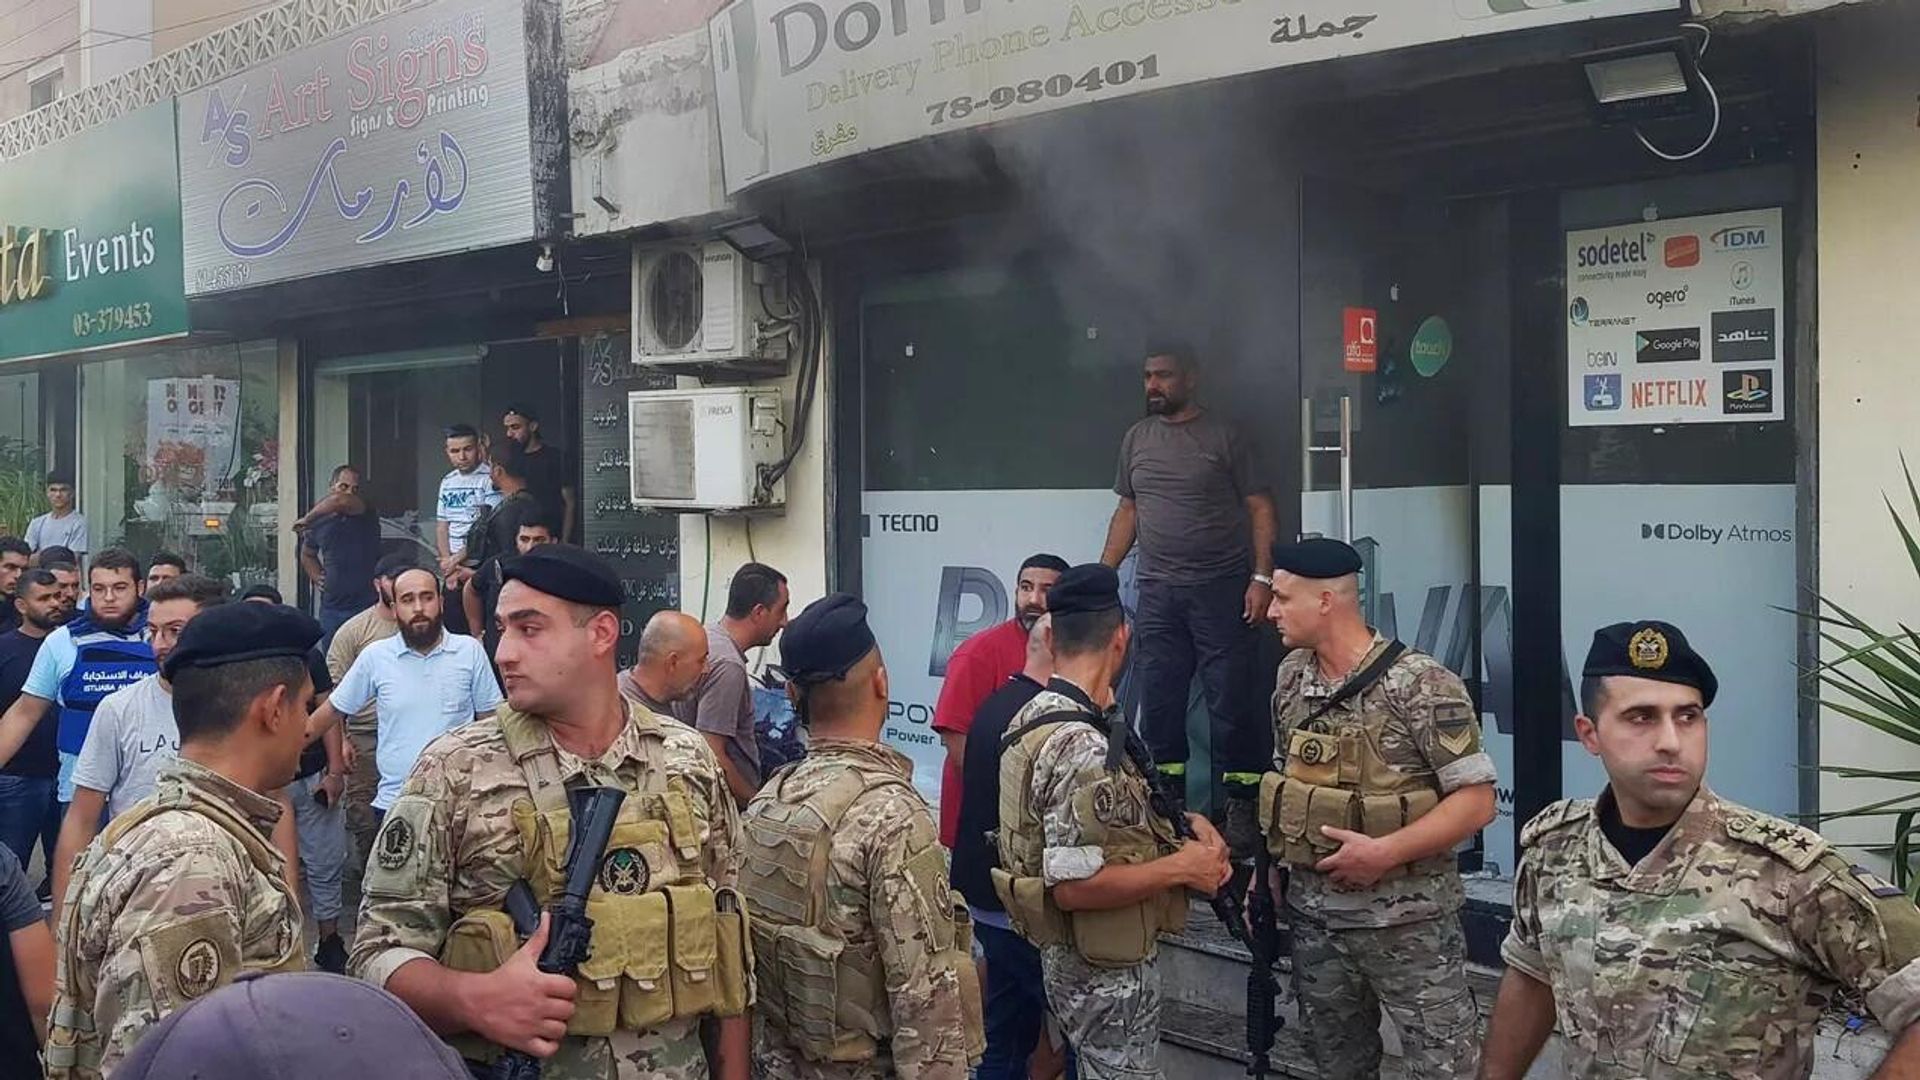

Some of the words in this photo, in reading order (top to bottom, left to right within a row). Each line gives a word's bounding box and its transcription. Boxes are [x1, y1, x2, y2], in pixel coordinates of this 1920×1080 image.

[1268, 12, 1378, 44] جملة
[806, 56, 922, 112] Delivery
[931, 24, 1051, 74] Phone
[257, 66, 334, 141] Art
[346, 30, 489, 129] Signs
[925, 54, 1160, 125] 78-980401
[350, 112, 383, 139] Signs
[426, 83, 490, 117] Printing
[811, 122, 859, 157] مفرق
[63, 220, 156, 282] Events
[1577, 232, 1648, 268] sodetel
[1722, 229, 1766, 248] IDM
[1729, 296, 1756, 307] iTunes
[72, 302, 153, 338] 03-379453
[1717, 329, 1769, 343] شاهد
[1652, 338, 1683, 352] Google
[1682, 337, 1700, 351] Play
[1631, 379, 1708, 410] NETFLIX
[878, 514, 940, 533] TECNO
[1668, 523, 1724, 545] Dolby
[1726, 524, 1793, 543] Atmos
[886, 728, 935, 745] Power
